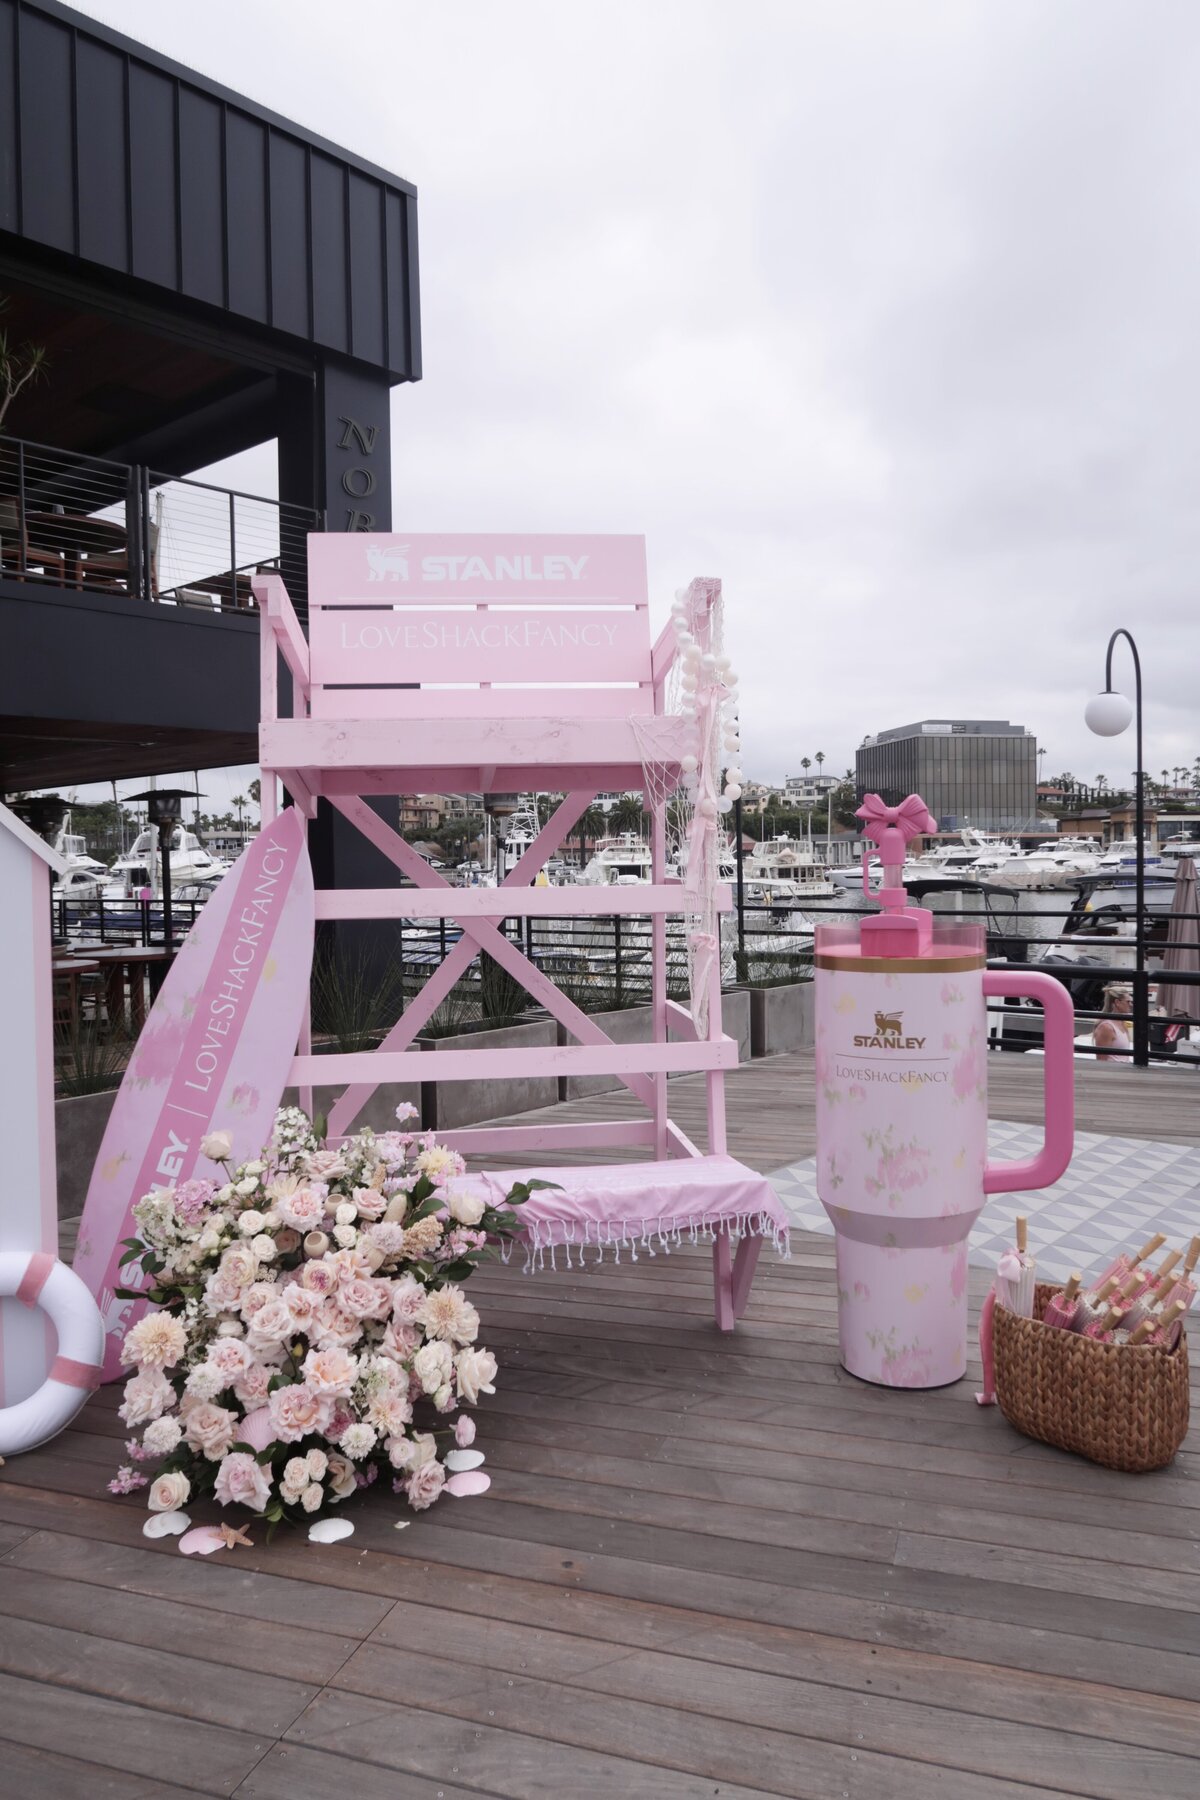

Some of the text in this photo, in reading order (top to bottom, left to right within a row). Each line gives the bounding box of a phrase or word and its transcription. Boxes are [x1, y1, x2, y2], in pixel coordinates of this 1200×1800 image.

[421, 555, 590, 581] STANLEY
[853, 1035, 926, 1049] STANLEY
[119, 1129, 189, 1289] SLEY
